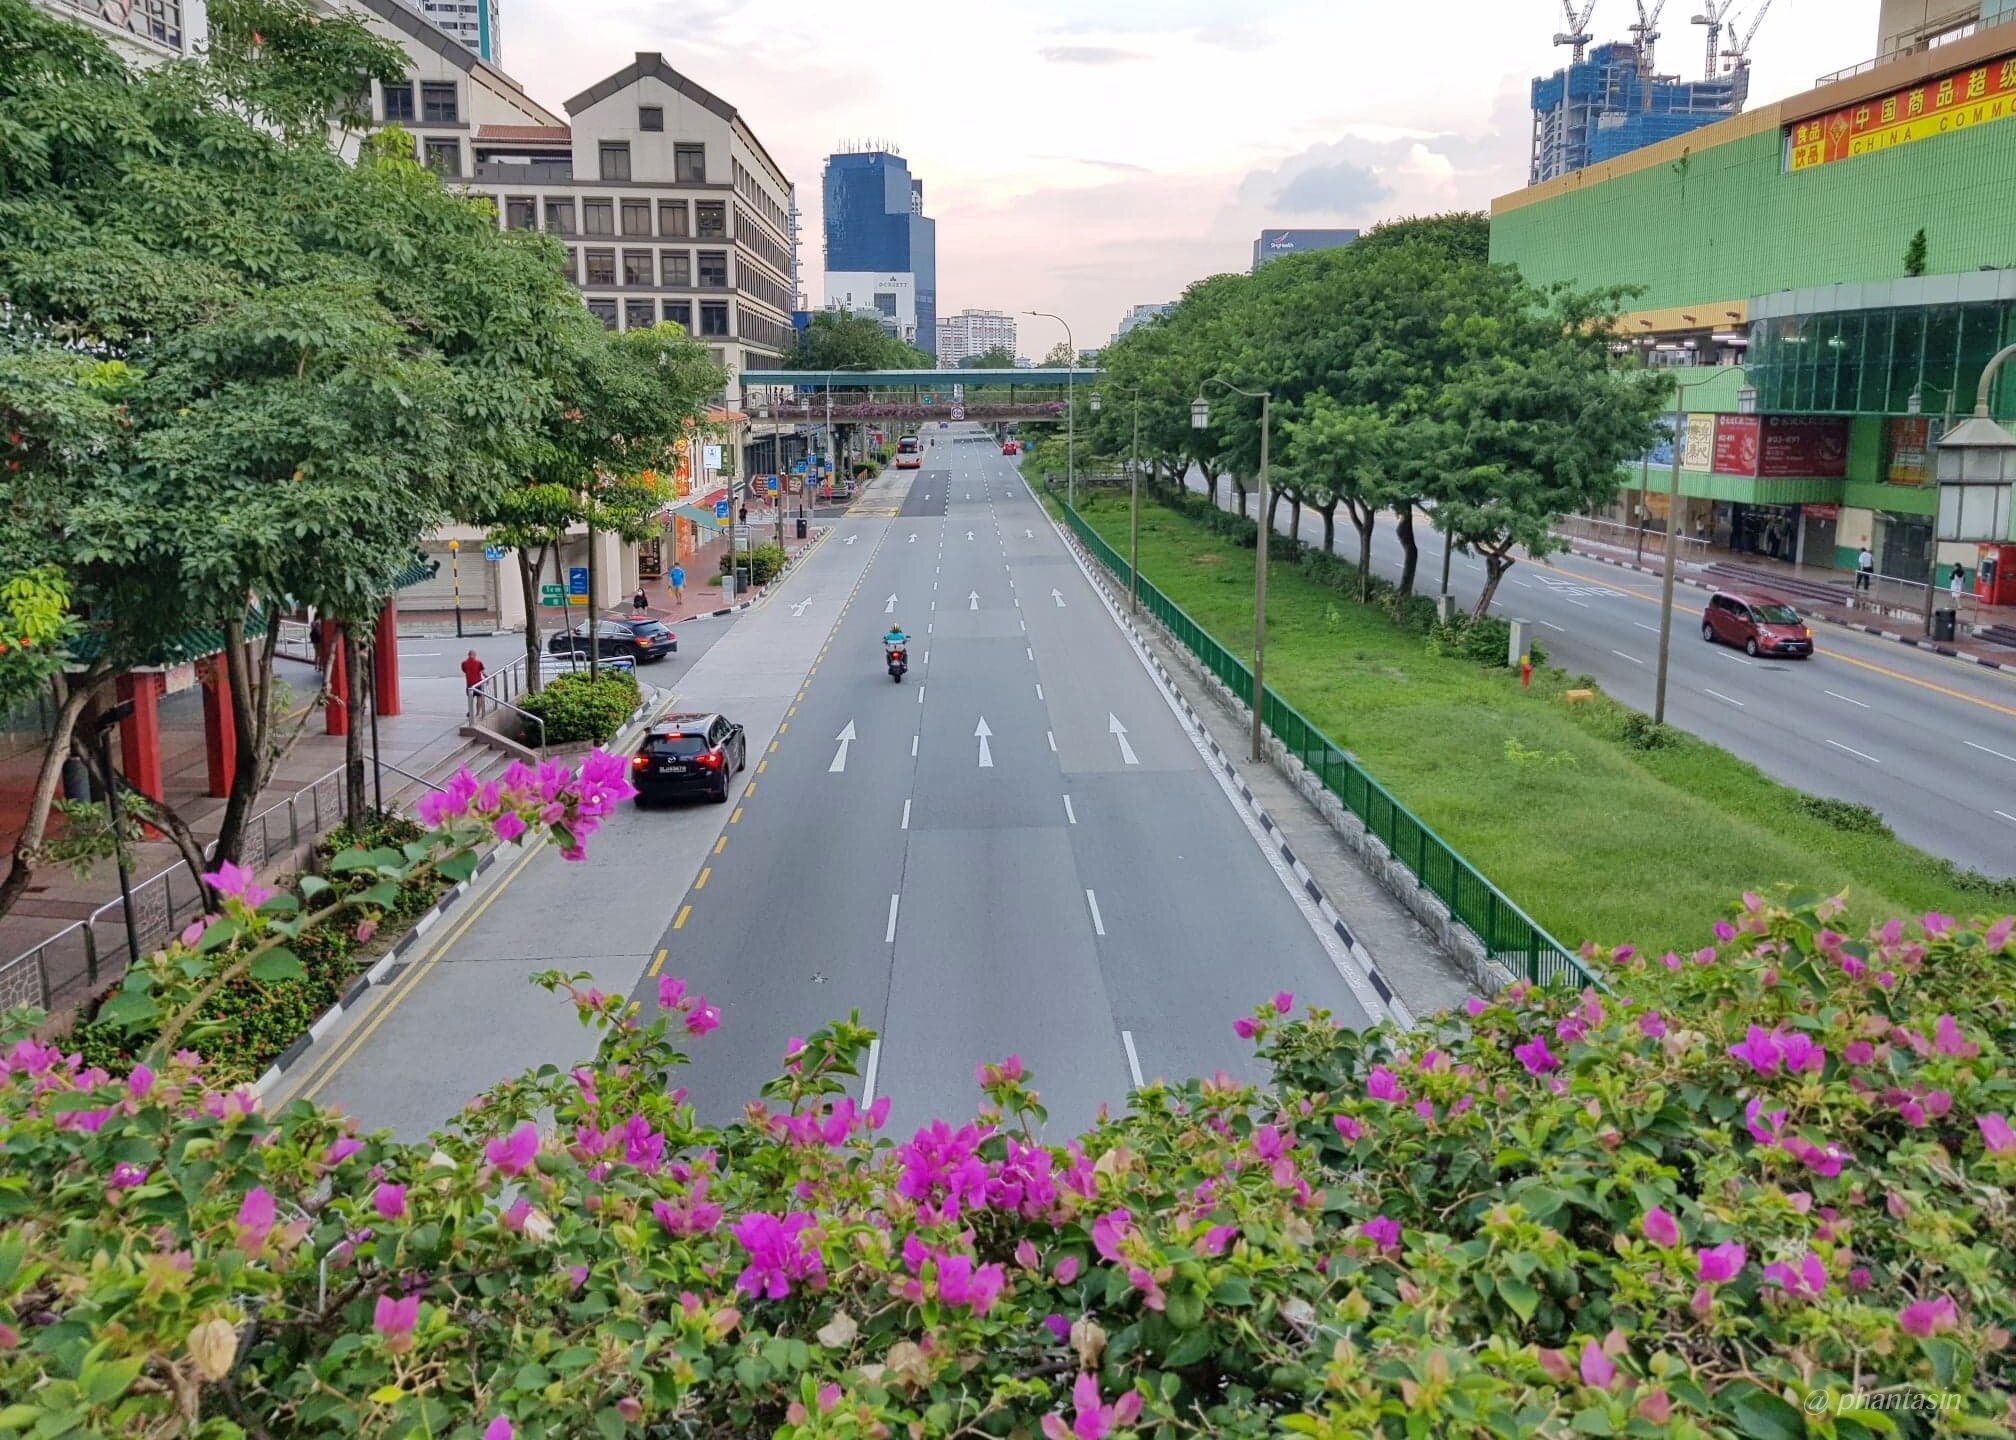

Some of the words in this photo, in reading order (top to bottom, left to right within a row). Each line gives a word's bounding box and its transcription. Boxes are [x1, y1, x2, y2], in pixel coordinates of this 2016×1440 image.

[1797, 121, 1820, 145] 食品
[1853, 127, 1912, 155] CHINA
[1796, 146, 1818, 169] 饮品
